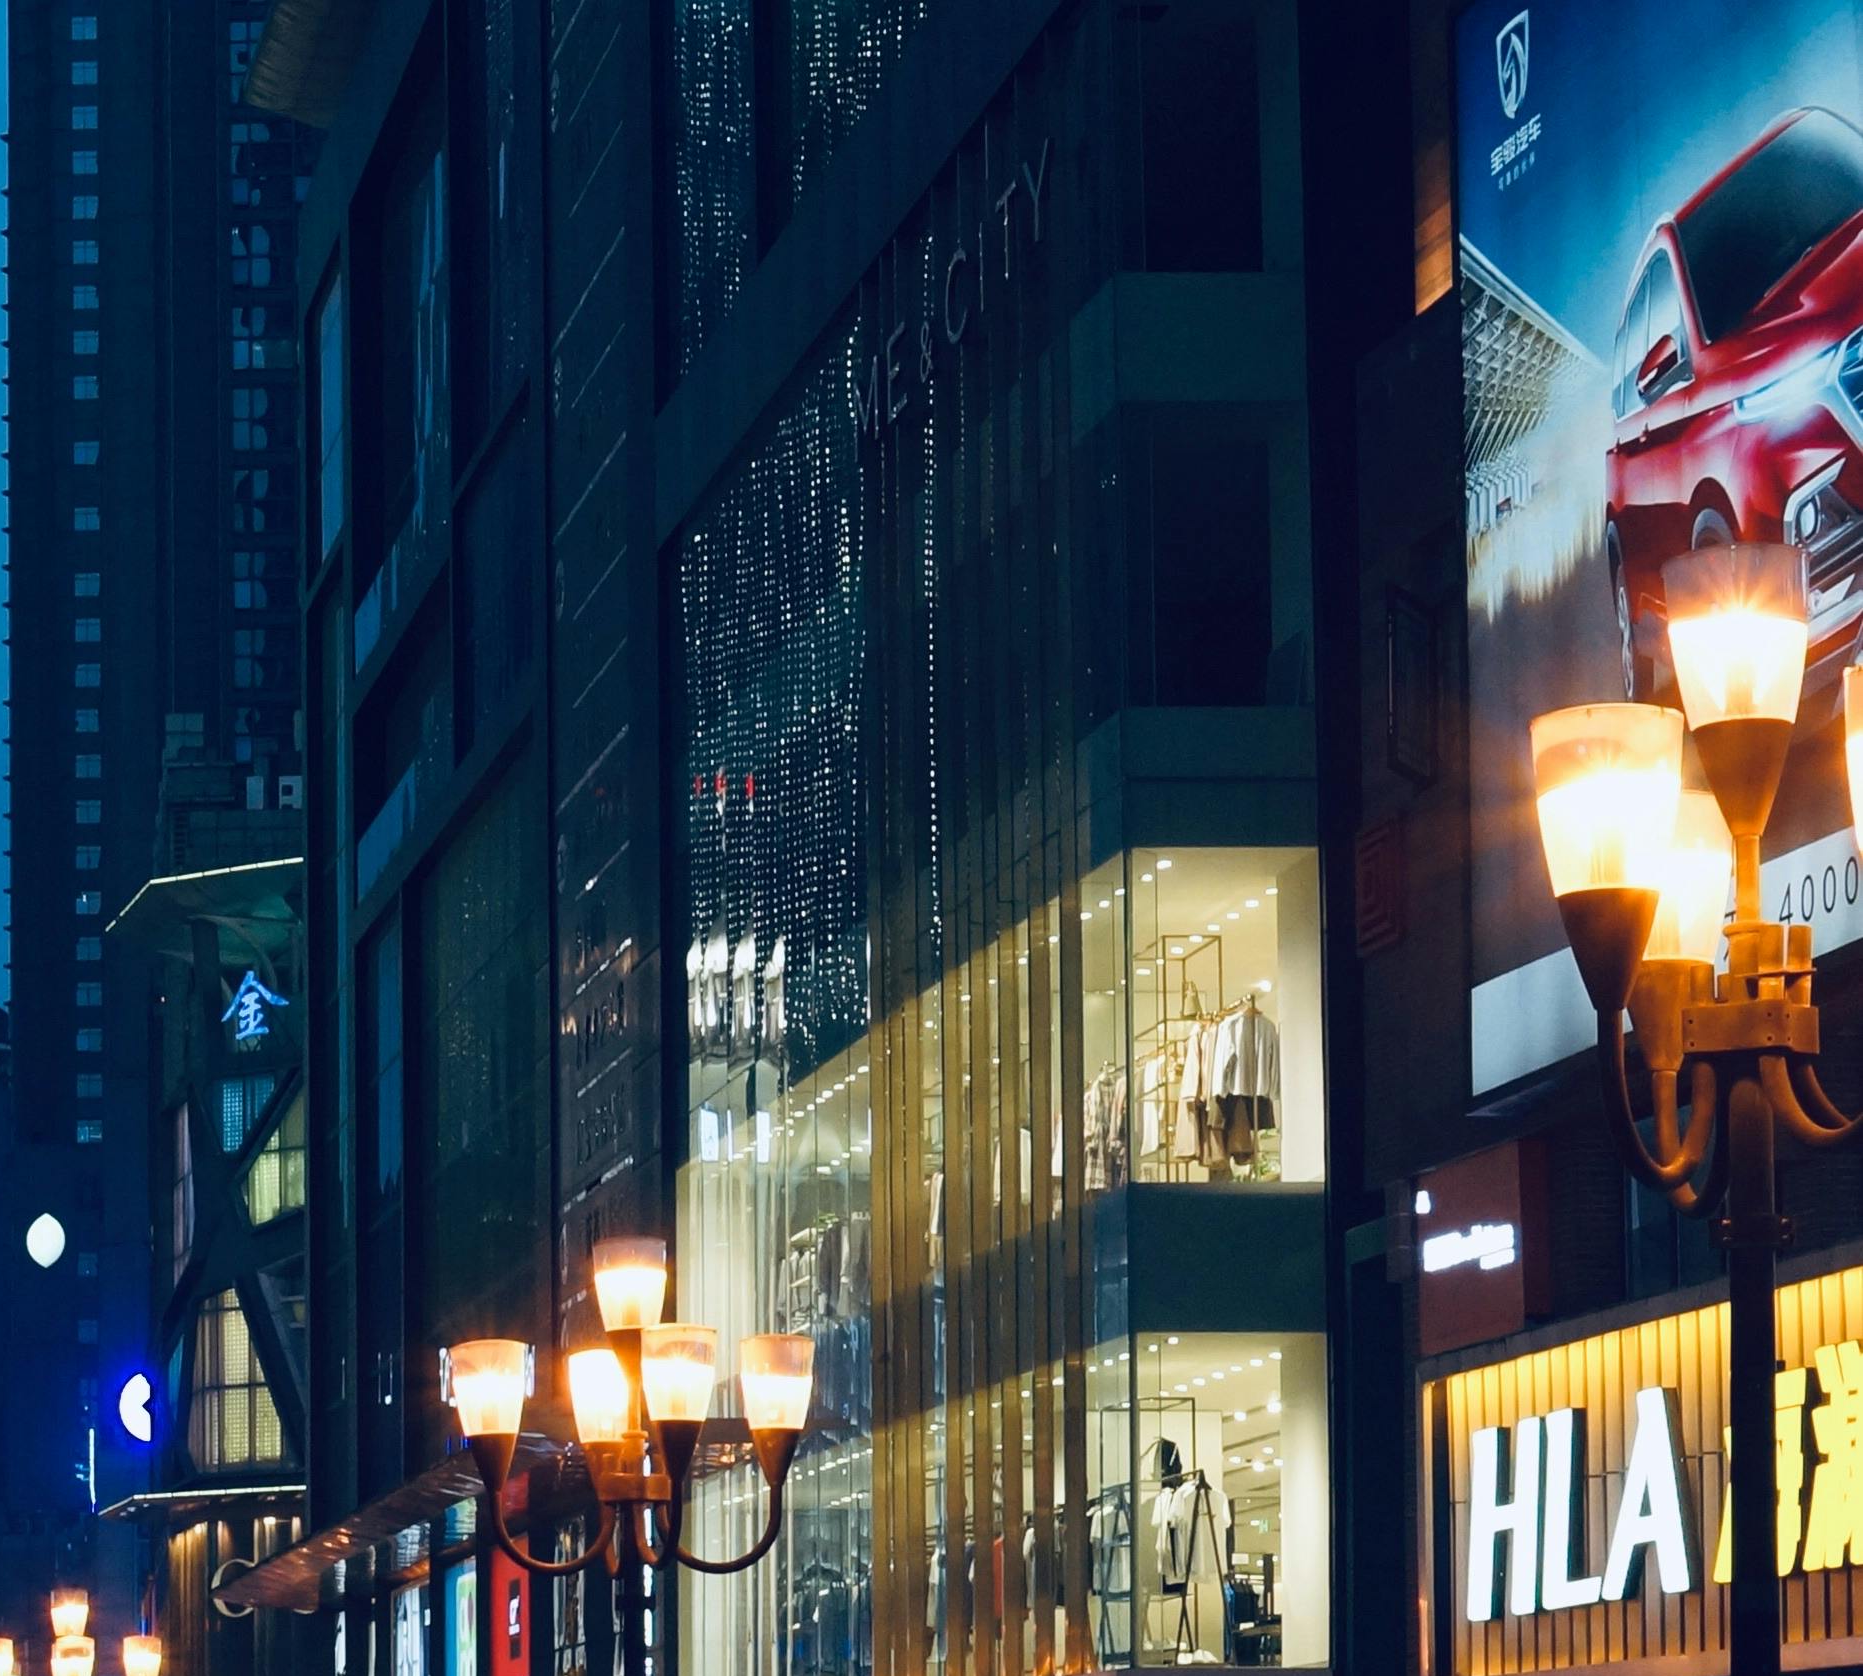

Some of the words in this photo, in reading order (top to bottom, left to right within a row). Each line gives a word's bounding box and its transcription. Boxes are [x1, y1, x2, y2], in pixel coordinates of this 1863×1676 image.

[1490, 112, 1541, 176] 宝骏汽车
[221, 971, 289, 1040] 金
[1466, 1386, 1691, 1622] HLA
